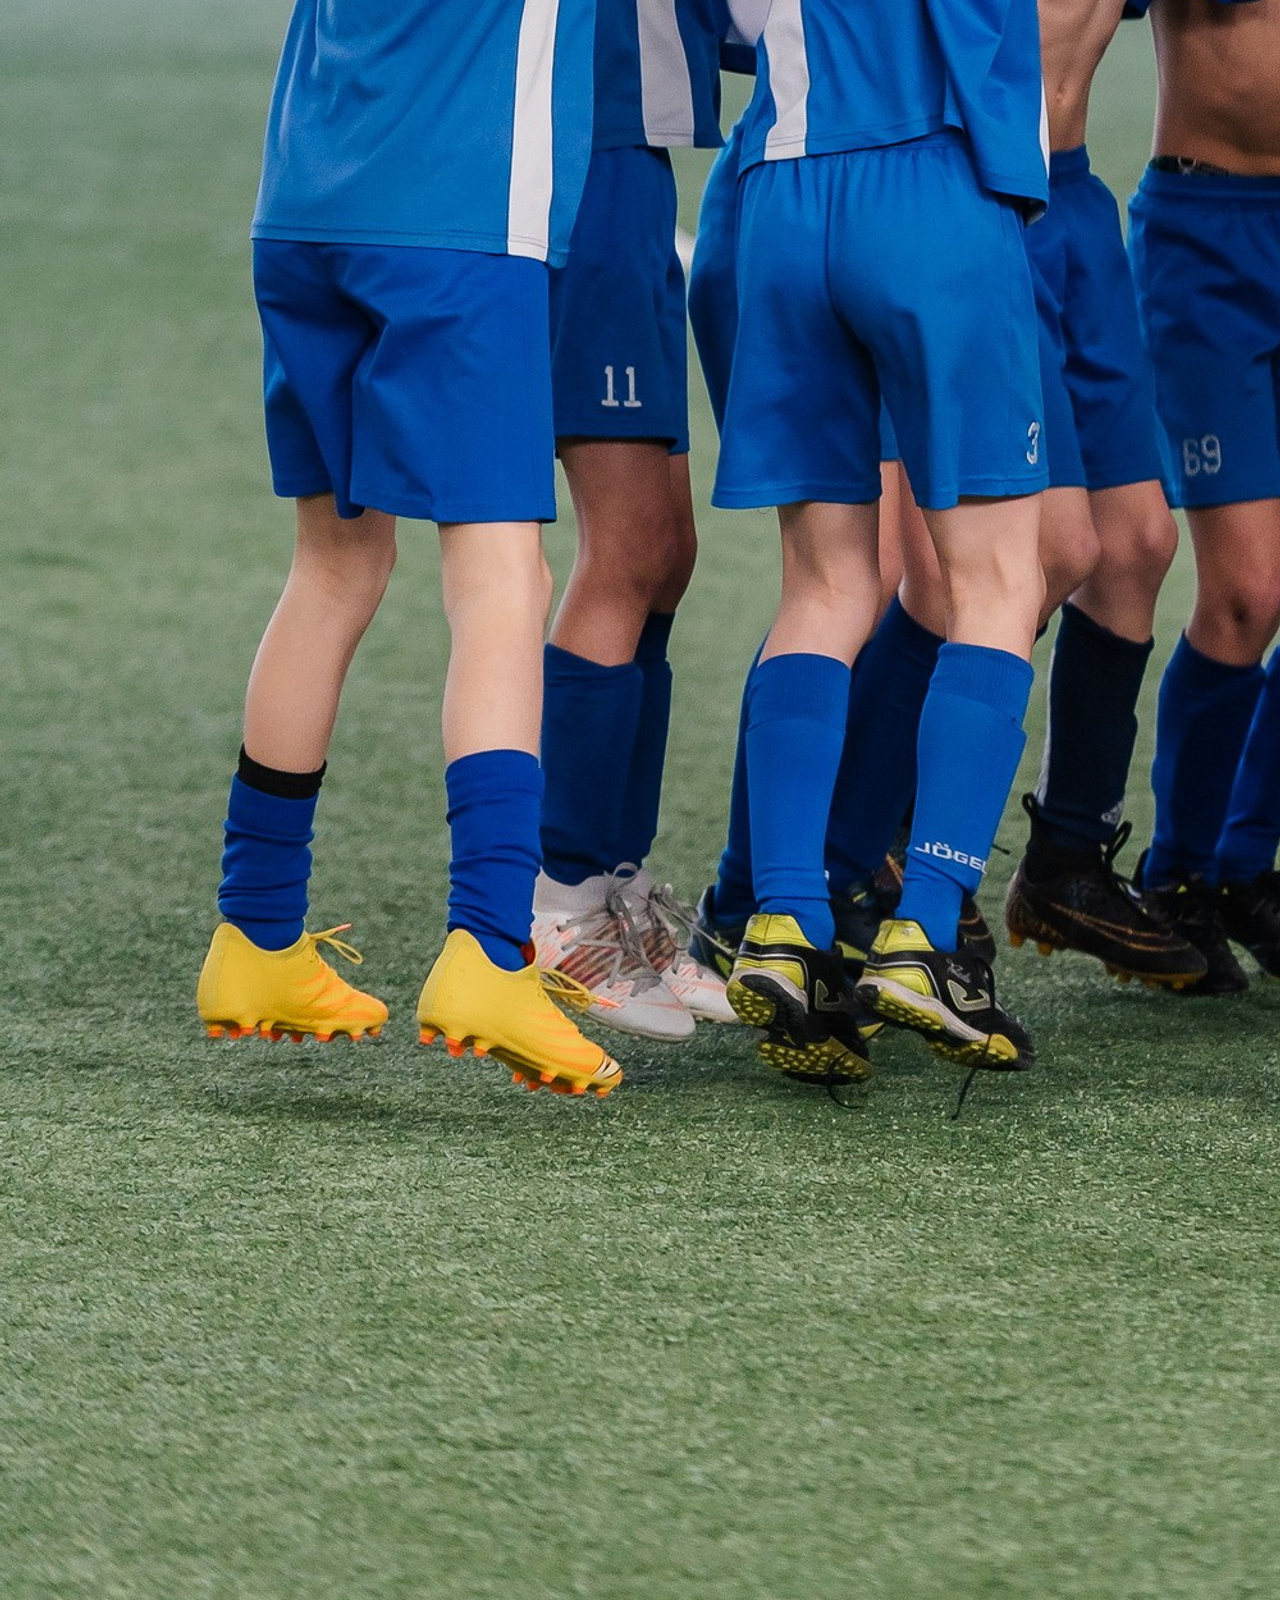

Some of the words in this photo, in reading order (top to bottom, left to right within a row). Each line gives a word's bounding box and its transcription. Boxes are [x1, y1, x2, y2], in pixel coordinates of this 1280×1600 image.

[601, 365, 642, 408] 11
[1026, 421, 1040, 465] 3
[1183, 434, 1222, 478] 69
